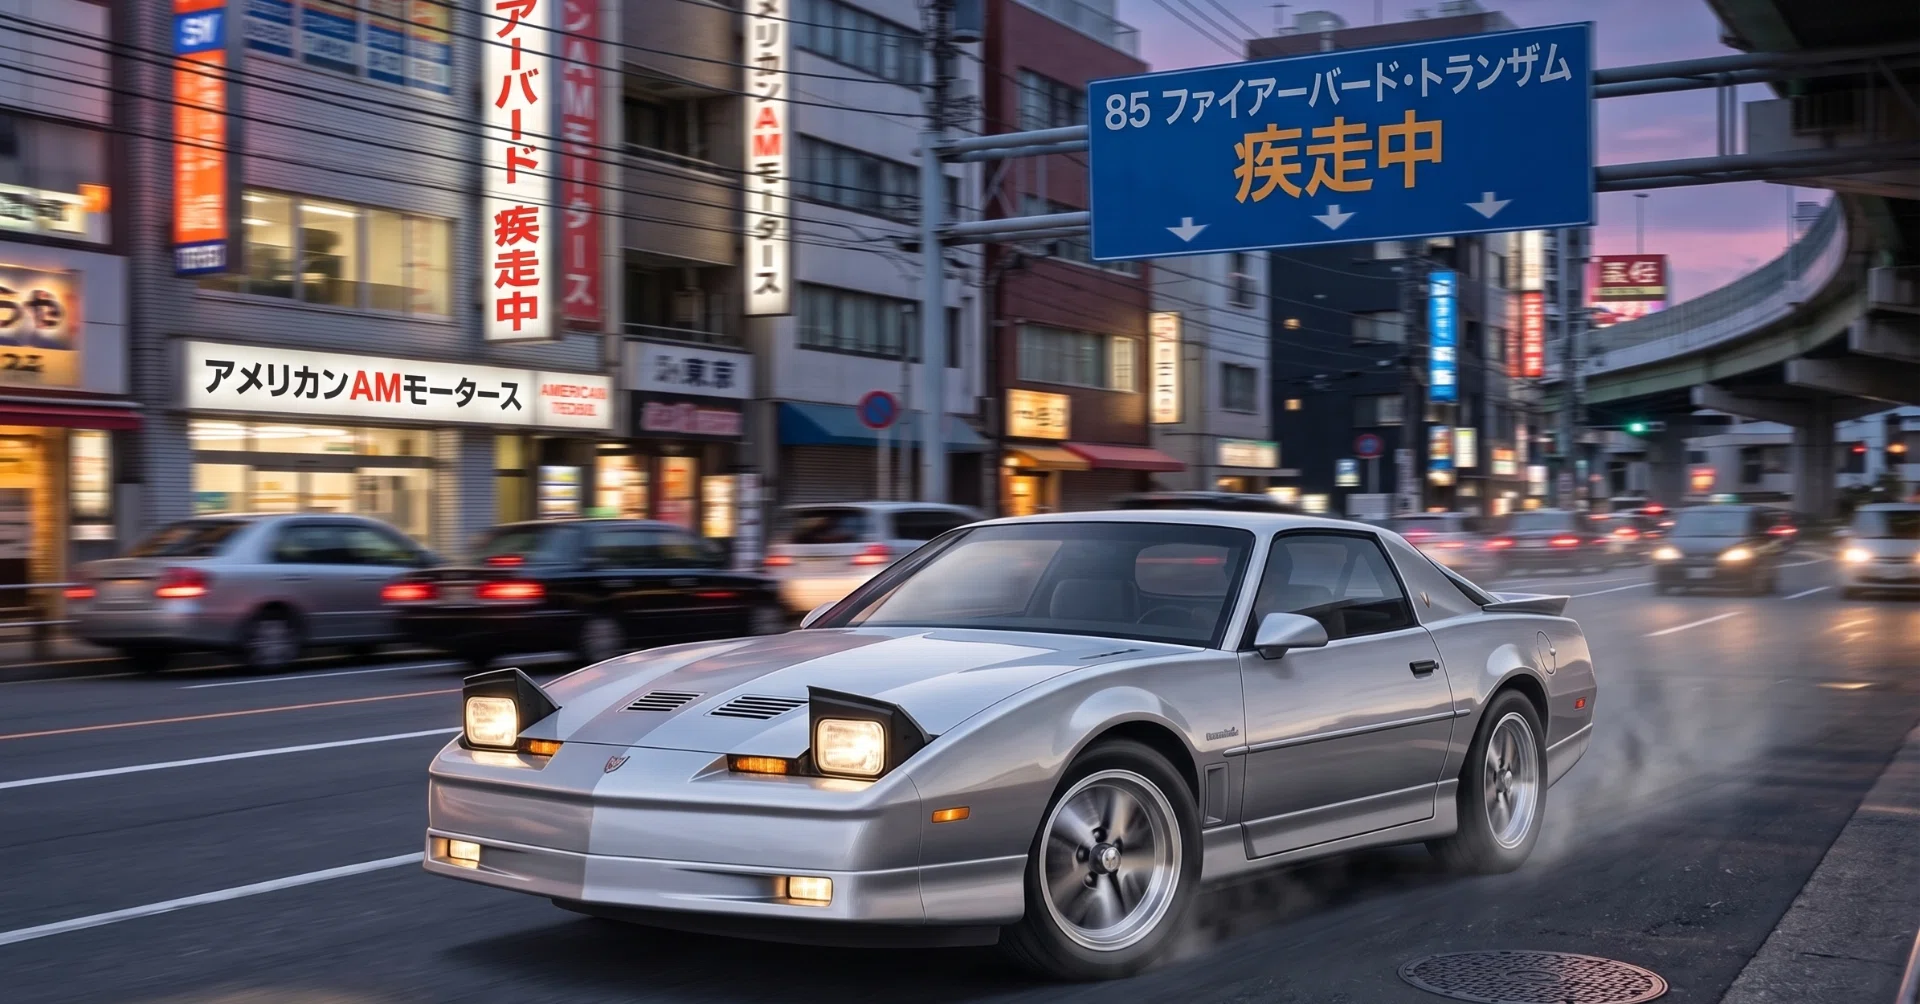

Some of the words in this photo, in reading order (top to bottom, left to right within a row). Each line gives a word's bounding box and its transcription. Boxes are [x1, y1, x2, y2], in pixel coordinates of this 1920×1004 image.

[495, 0, 540, 185] アーバード
[1105, 90, 1151, 131] 85
[1162, 43, 1572, 125] ファイアーバード・トランザム
[1233, 109, 1443, 204] 疾走中
[494, 205, 540, 332] 疾走中
[205, 359, 522, 411] アメリカンAMモータース
